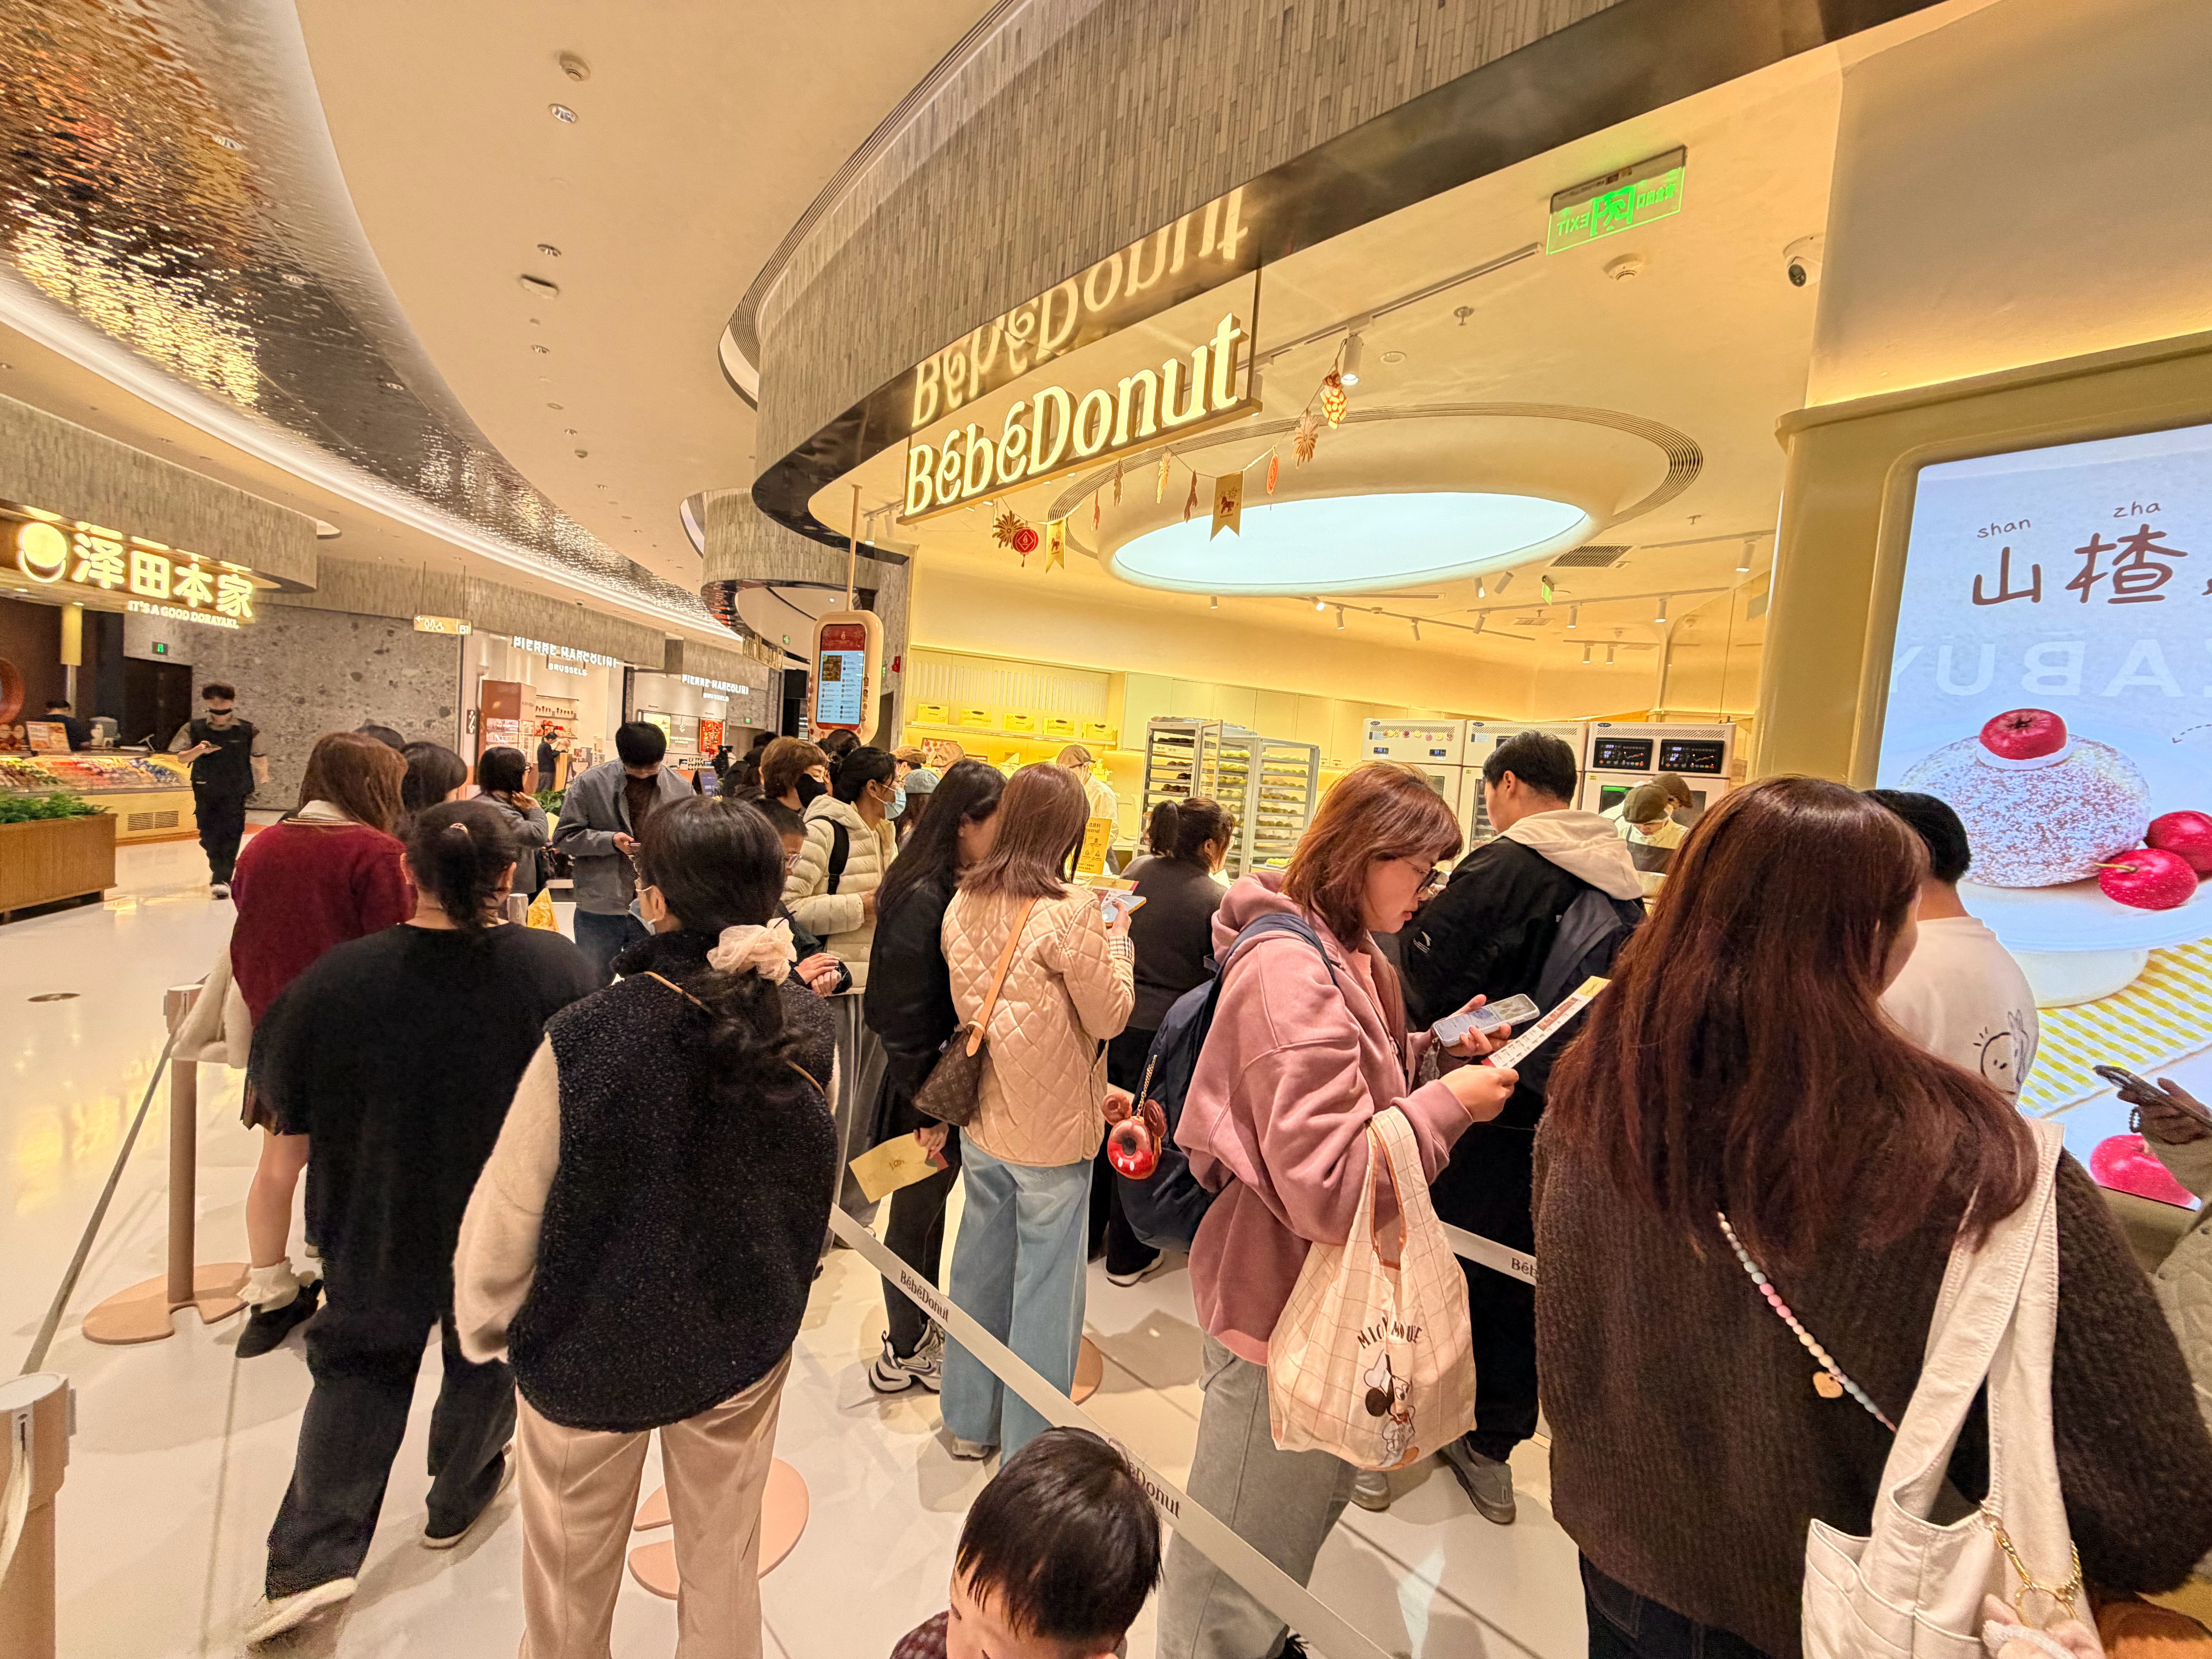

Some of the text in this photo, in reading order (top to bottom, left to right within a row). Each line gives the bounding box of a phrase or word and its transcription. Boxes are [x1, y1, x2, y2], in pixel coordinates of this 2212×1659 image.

[905, 313, 1242, 516] BébéDonut
[1977, 501, 2162, 539] shan zha
[72, 532, 253, 619] 泽田本家
[1972, 524, 2212, 606] 山楂
[128, 600, 150, 614] IT'S
[150, 604, 160, 615] A
[160, 606, 190, 621] GOOD
[513, 635, 617, 668] PIERRE MARCOLINI
[548, 663, 588, 677] BRUSSELS
[682, 673, 749, 695] PIERRE MARCOLINI
[703, 692, 730, 702] BRUSSELS
[900, 1269, 950, 1323] BébéDonut
